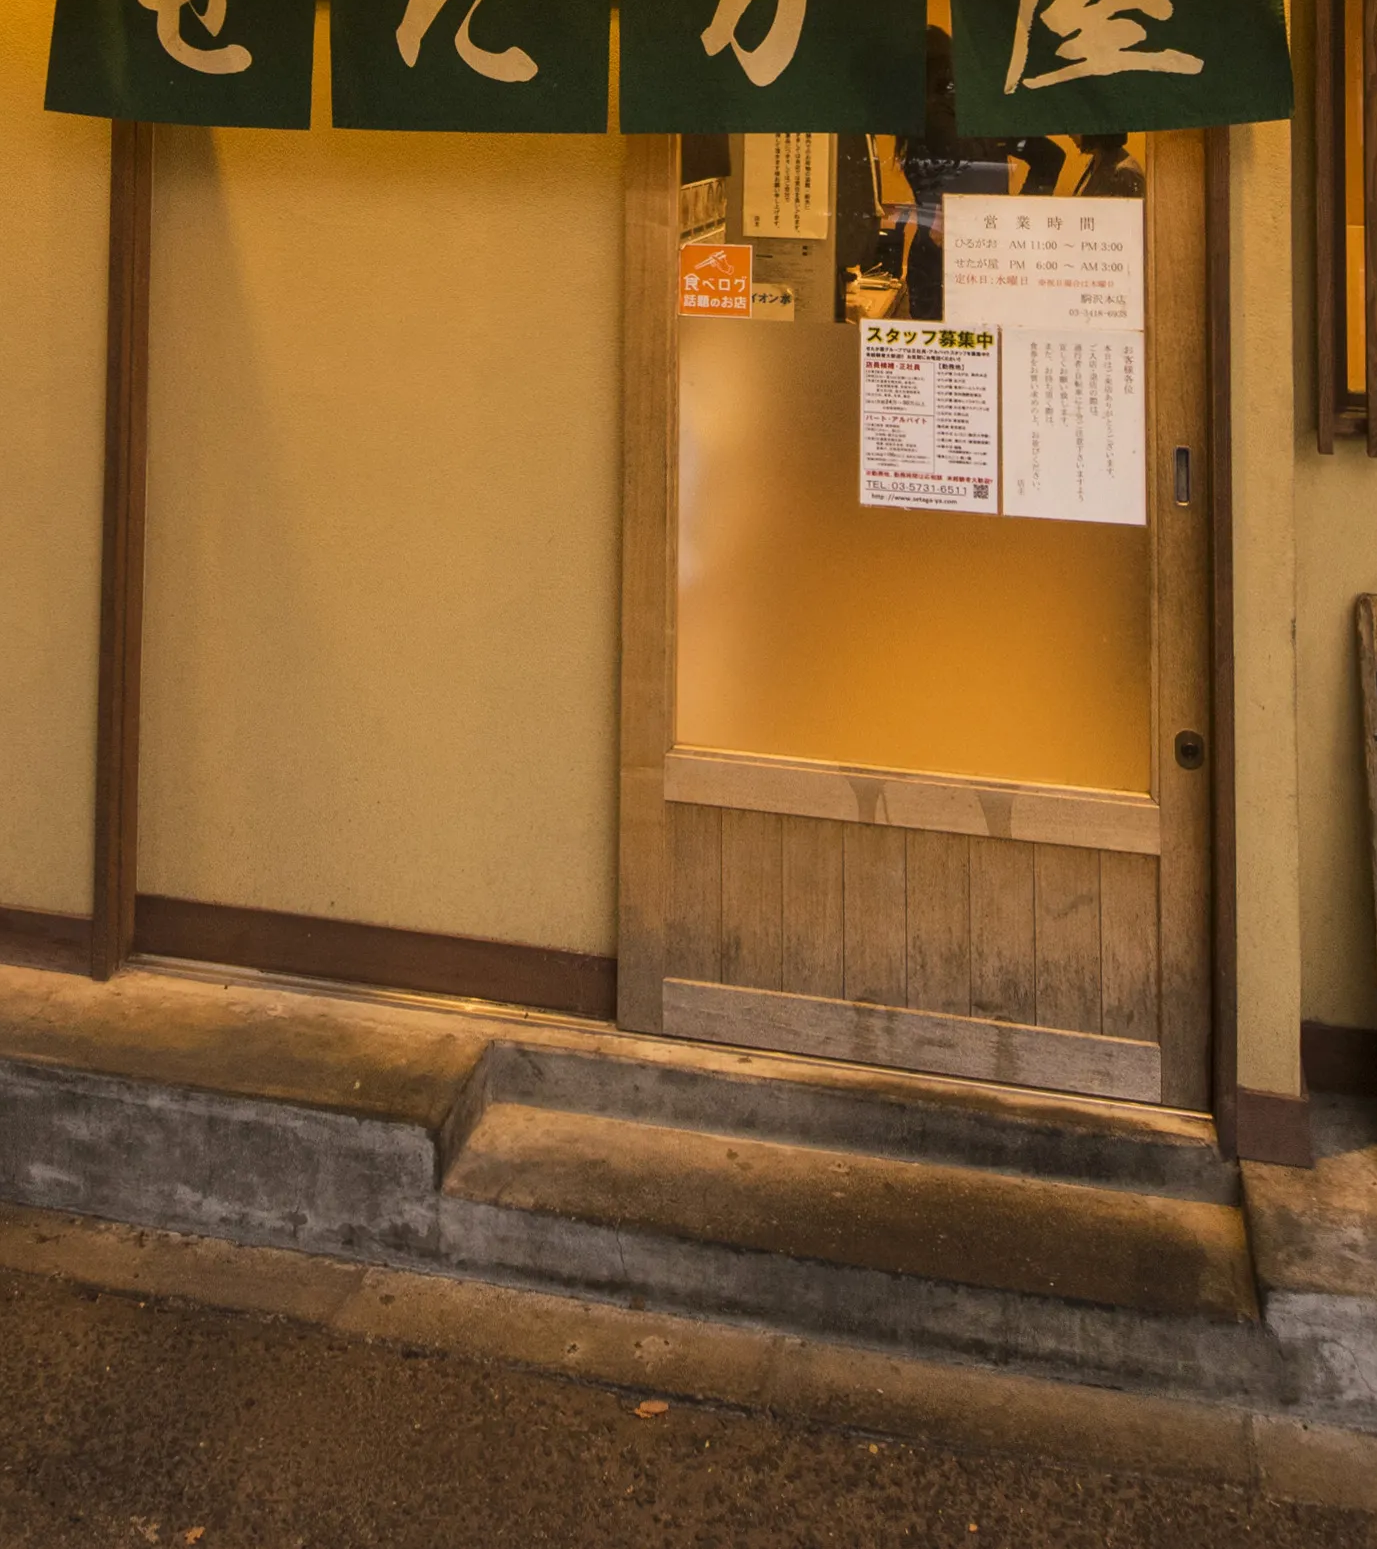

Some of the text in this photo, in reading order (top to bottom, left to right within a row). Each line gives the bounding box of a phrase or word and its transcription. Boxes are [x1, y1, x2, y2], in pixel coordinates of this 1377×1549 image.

[984, 215, 1095, 232] 営業時間
[954, 238, 998, 249] ひるがお
[1009, 241, 1026, 250] AM
[1031, 241, 1057, 250] 11:00
[1081, 242, 1097, 251] PM
[1101, 242, 1123, 252] 3:00
[955, 258, 999, 270] せたが屋
[1009, 261, 1025, 270] PM
[1036, 261, 1058, 271] 6:00
[1080, 262, 1098, 272] AM
[1101, 262, 1123, 272] 3:00
[683, 273, 747, 292] 食べログ
[683, 294, 747, 310] 話題のお店
[1081, 294, 1126, 305] 駒沢本店
[867, 327, 994, 349] スタッフ募集中
[1124, 345, 1135, 394] お客様各位
